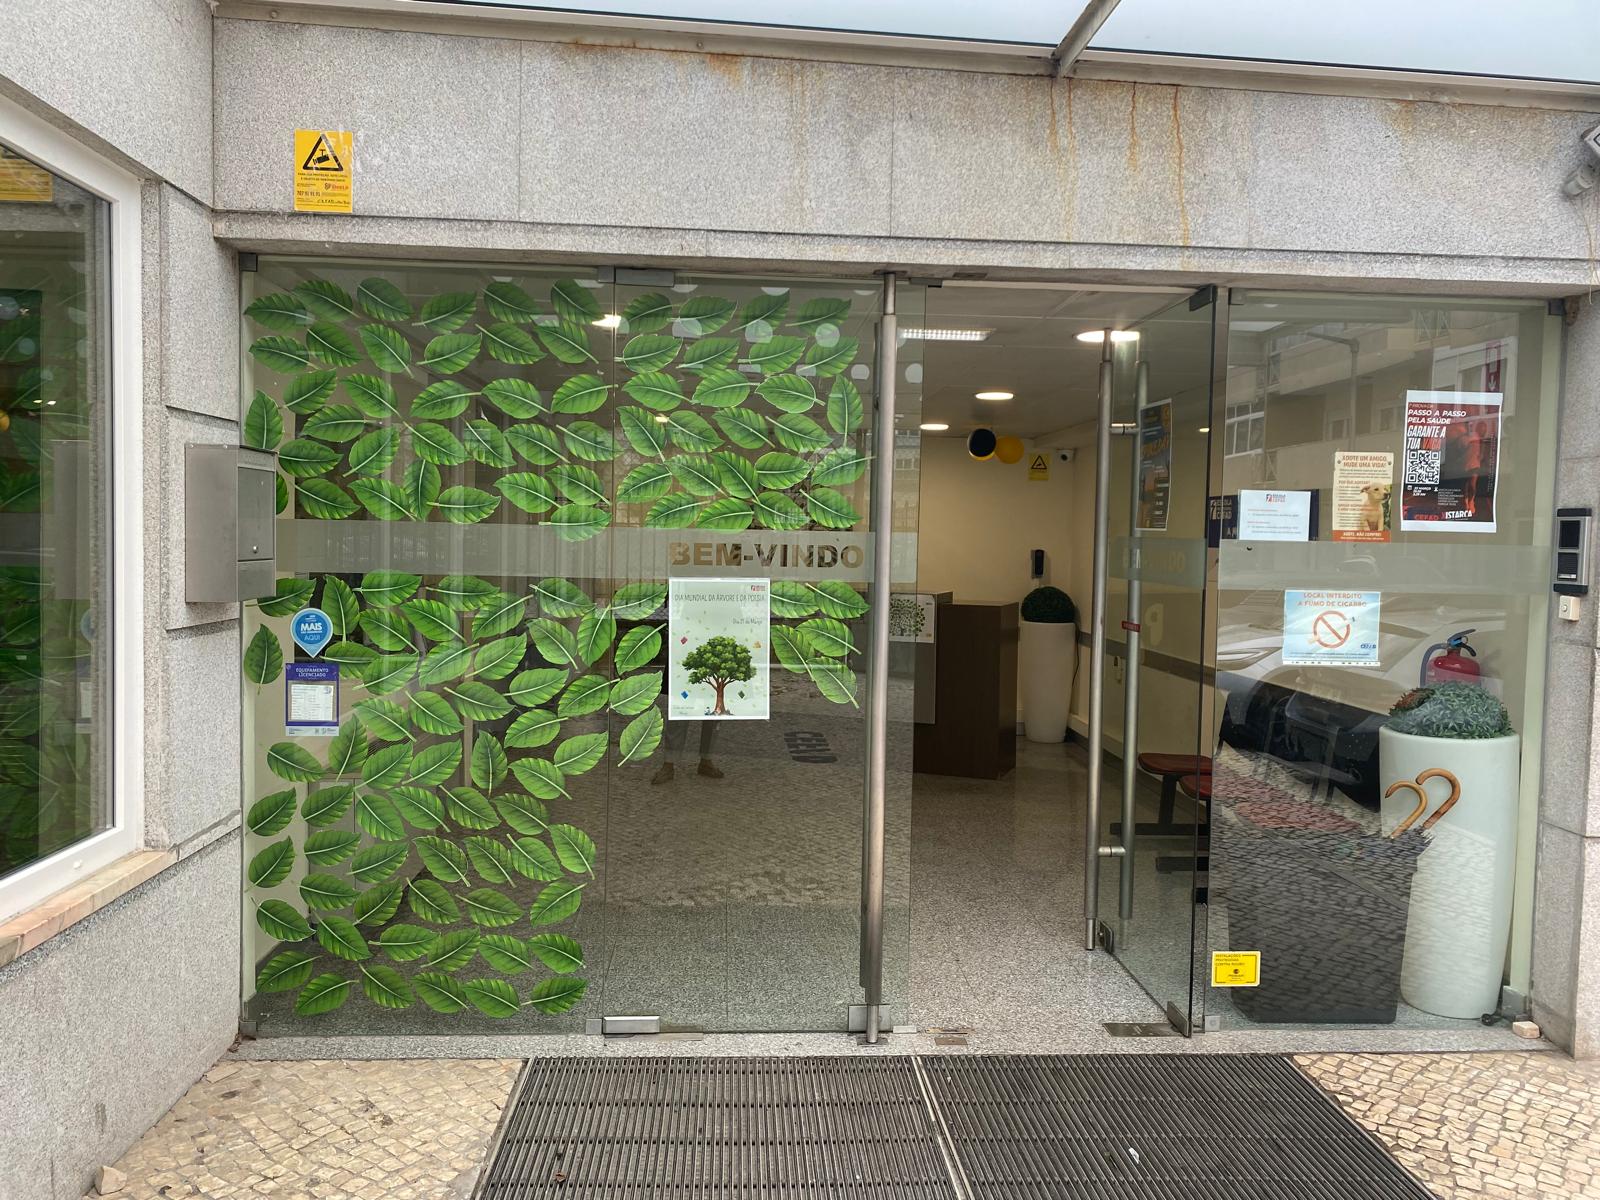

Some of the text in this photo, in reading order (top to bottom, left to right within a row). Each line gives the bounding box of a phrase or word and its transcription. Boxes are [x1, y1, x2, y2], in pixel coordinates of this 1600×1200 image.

[1407, 425, 1446, 438] GARANTE A
[1407, 438, 1420, 450] TUA
[669, 542, 864, 568] BEM-VINDO
[301, 623, 322, 631] MAIS
